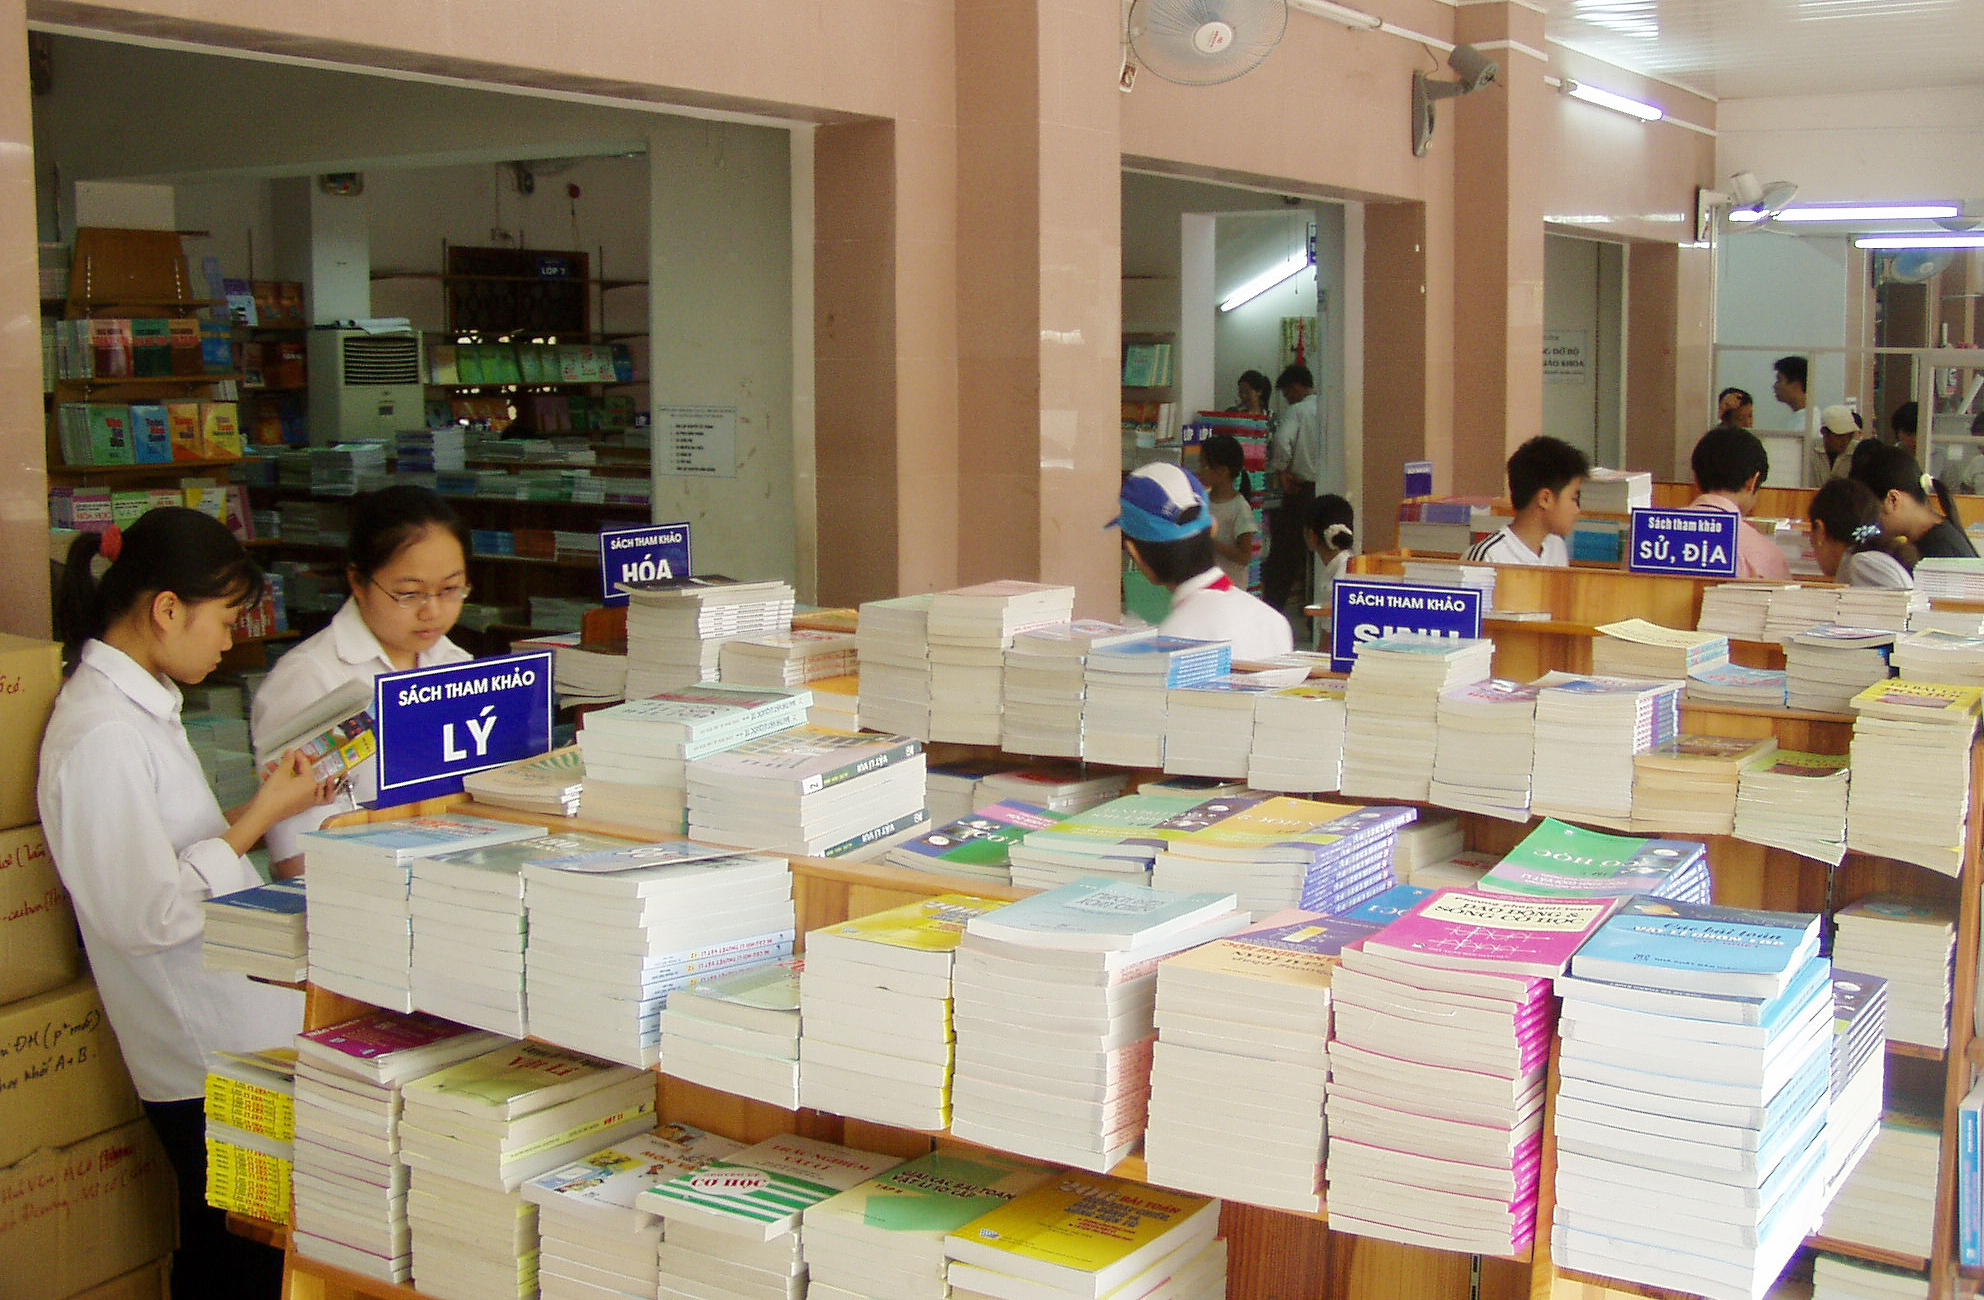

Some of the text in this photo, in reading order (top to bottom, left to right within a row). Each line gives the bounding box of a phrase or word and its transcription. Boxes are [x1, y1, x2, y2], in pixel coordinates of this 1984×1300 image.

[1648, 517, 1722, 533] Sách tham khảo
[611, 531, 683, 550] SÁCH THAM KHẢO
[1640, 535, 1727, 567] SỬ, ĐỊA
[622, 553, 673, 583] HÓA
[1349, 591, 1466, 612] SÁCH THAM KHẢO
[398, 667, 536, 707] SÁCH THAM KHẢO
[443, 704, 498, 763] LÝ
[1533, 850, 1593, 866] HỌC
[723, 1177, 769, 1191] HỌC
